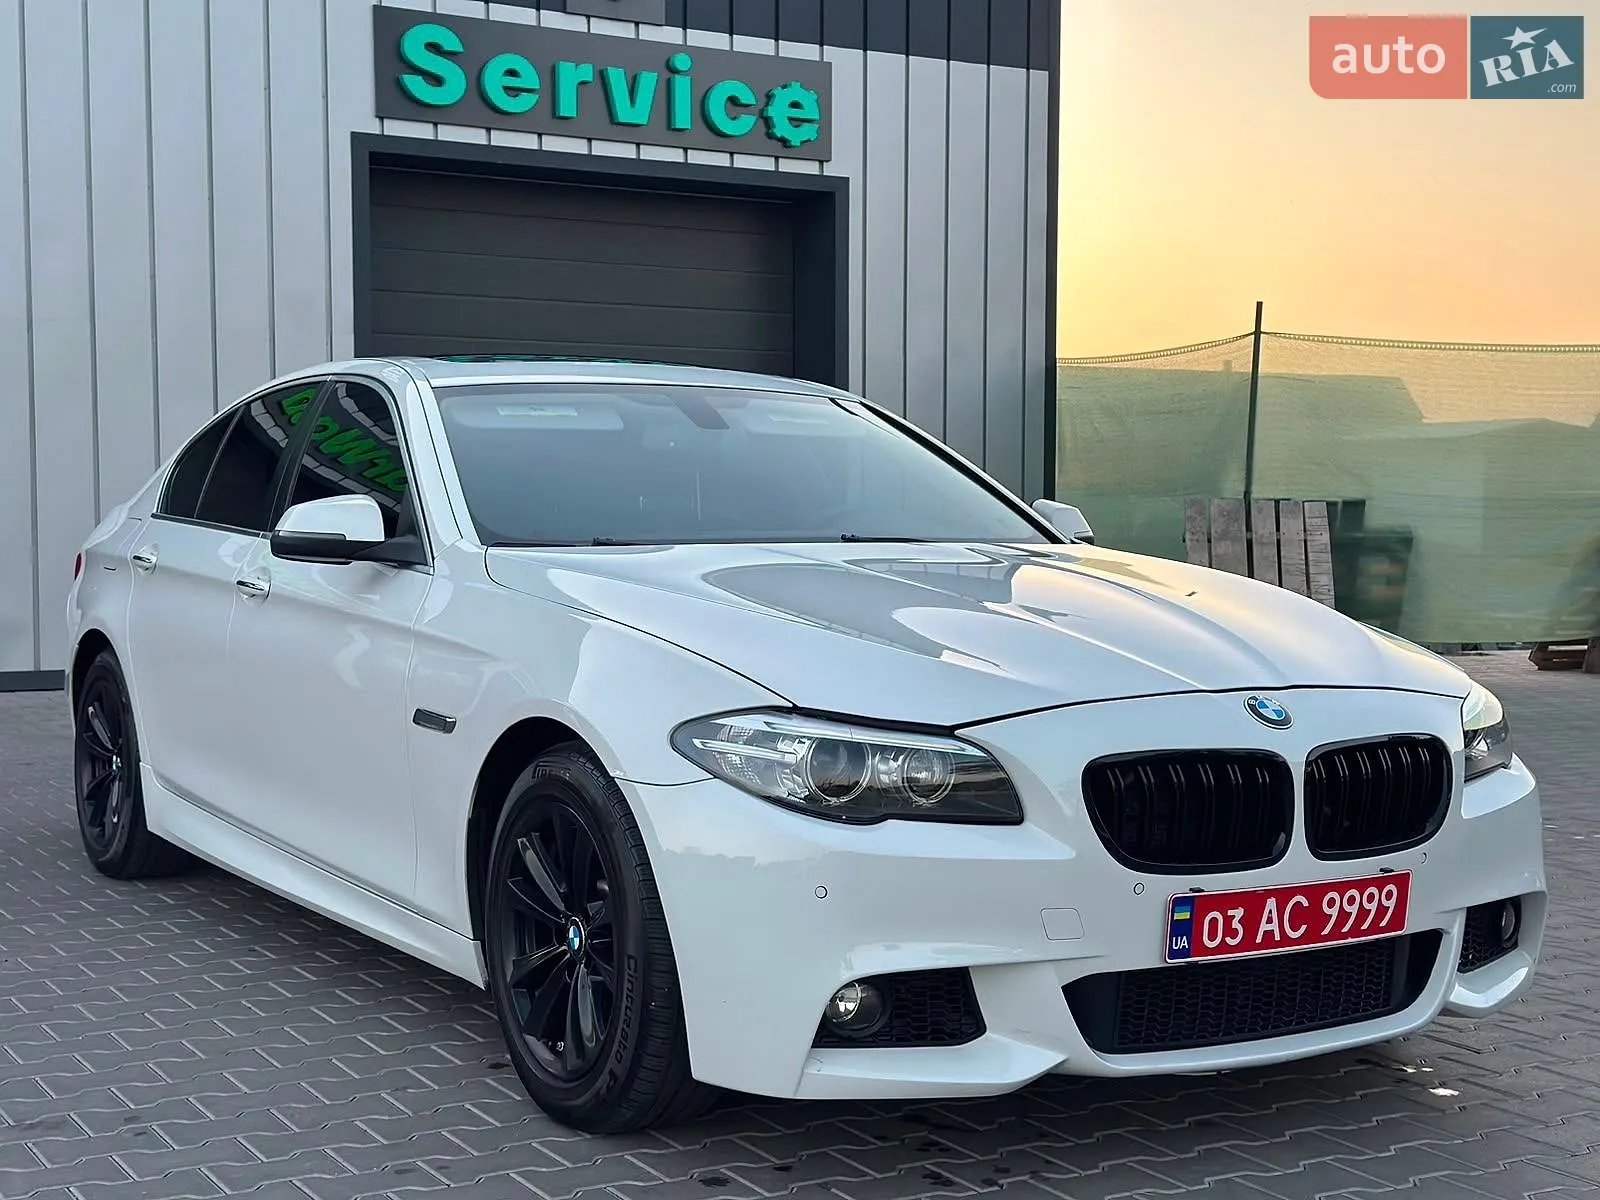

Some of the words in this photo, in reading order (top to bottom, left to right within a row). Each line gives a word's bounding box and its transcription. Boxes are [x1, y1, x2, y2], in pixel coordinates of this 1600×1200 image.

[398, 23, 821, 147] Service
[1172, 936, 1189, 950] UA
[1203, 908, 1244, 948] 03
[1256, 895, 1309, 944] AC
[1322, 884, 1398, 935] 9999
